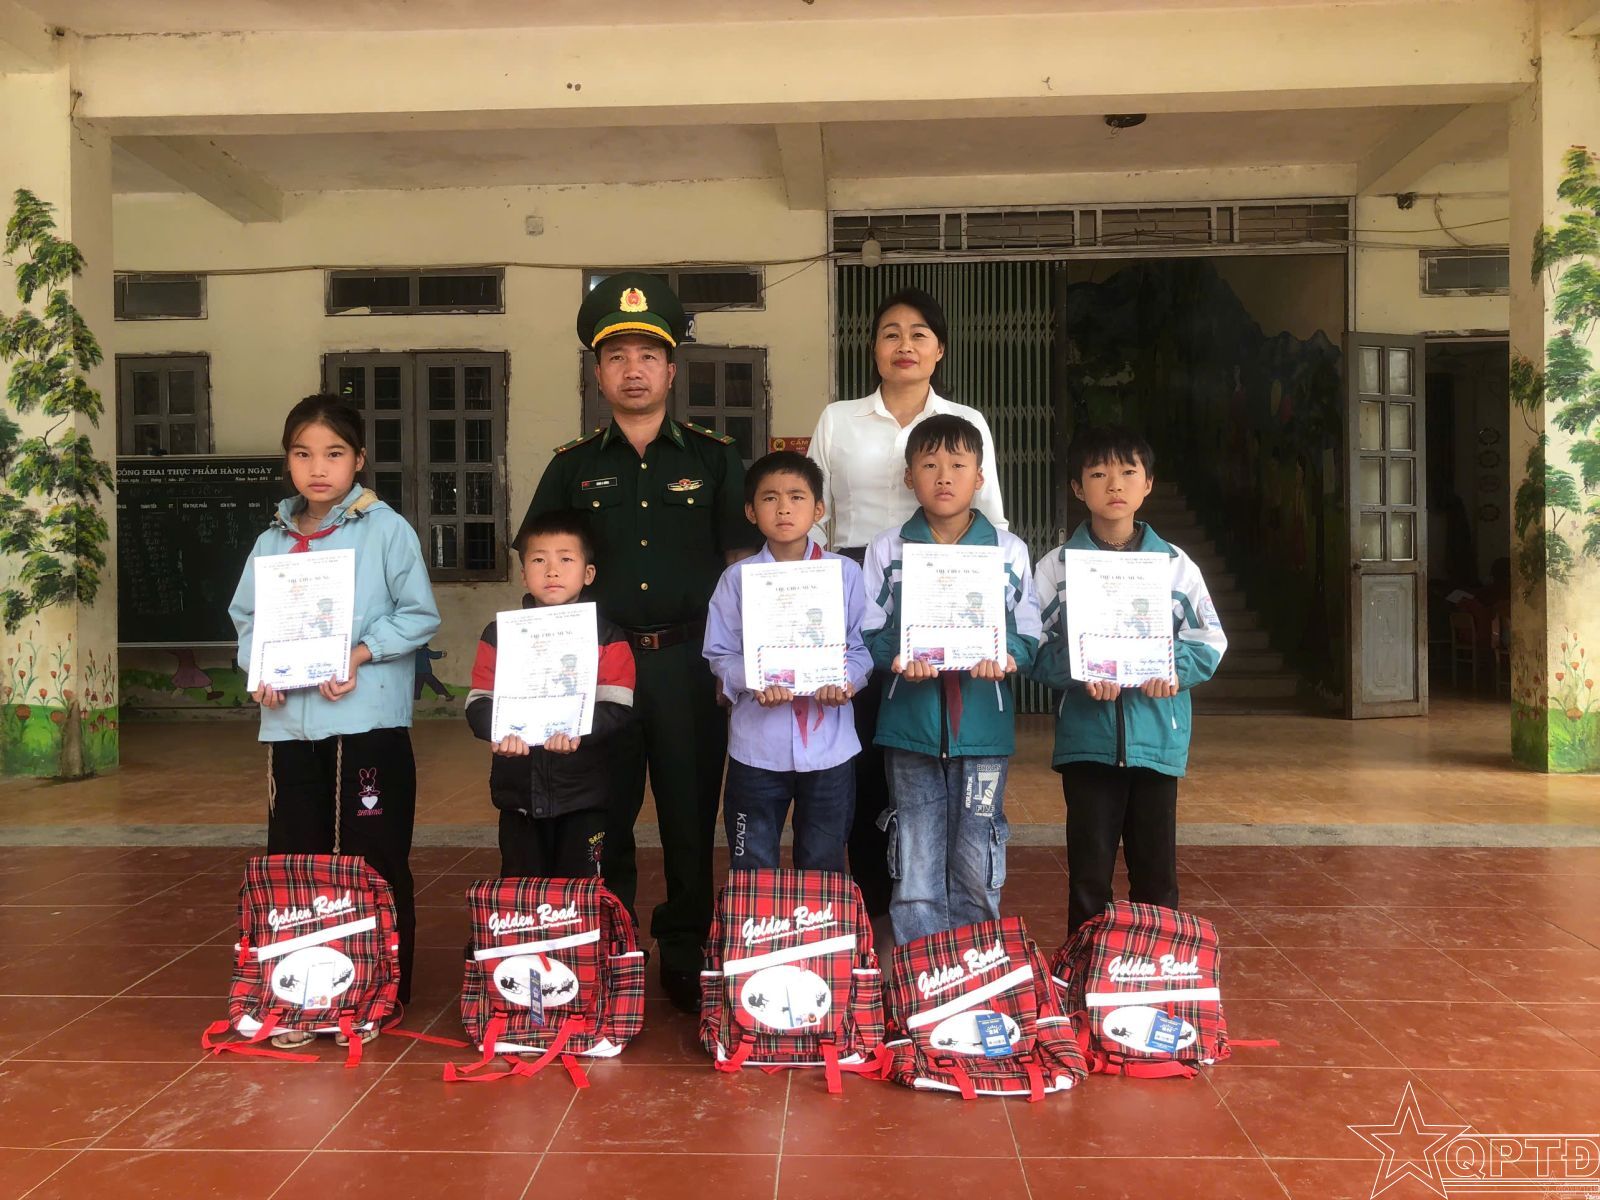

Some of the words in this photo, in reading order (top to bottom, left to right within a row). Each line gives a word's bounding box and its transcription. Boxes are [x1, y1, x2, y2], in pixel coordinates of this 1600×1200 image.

[166, 468, 191, 477] THỰC
[192, 464, 218, 475] PHẨM
[220, 466, 246, 475] HÀNG
[247, 465, 273, 474] NGÀY
[734, 812, 748, 857] KENZO
[268, 905, 313, 933] Golden
[313, 889, 352, 916] Road
[488, 911, 535, 937] Golden
[536, 900, 578, 926] Road
[741, 915, 791, 948] Golden
[793, 901, 834, 929] Road
[917, 963, 965, 1001] Golden
[963, 938, 1006, 974] Road
[1107, 955, 1157, 983] Golden
[1159, 953, 1199, 976] Road
